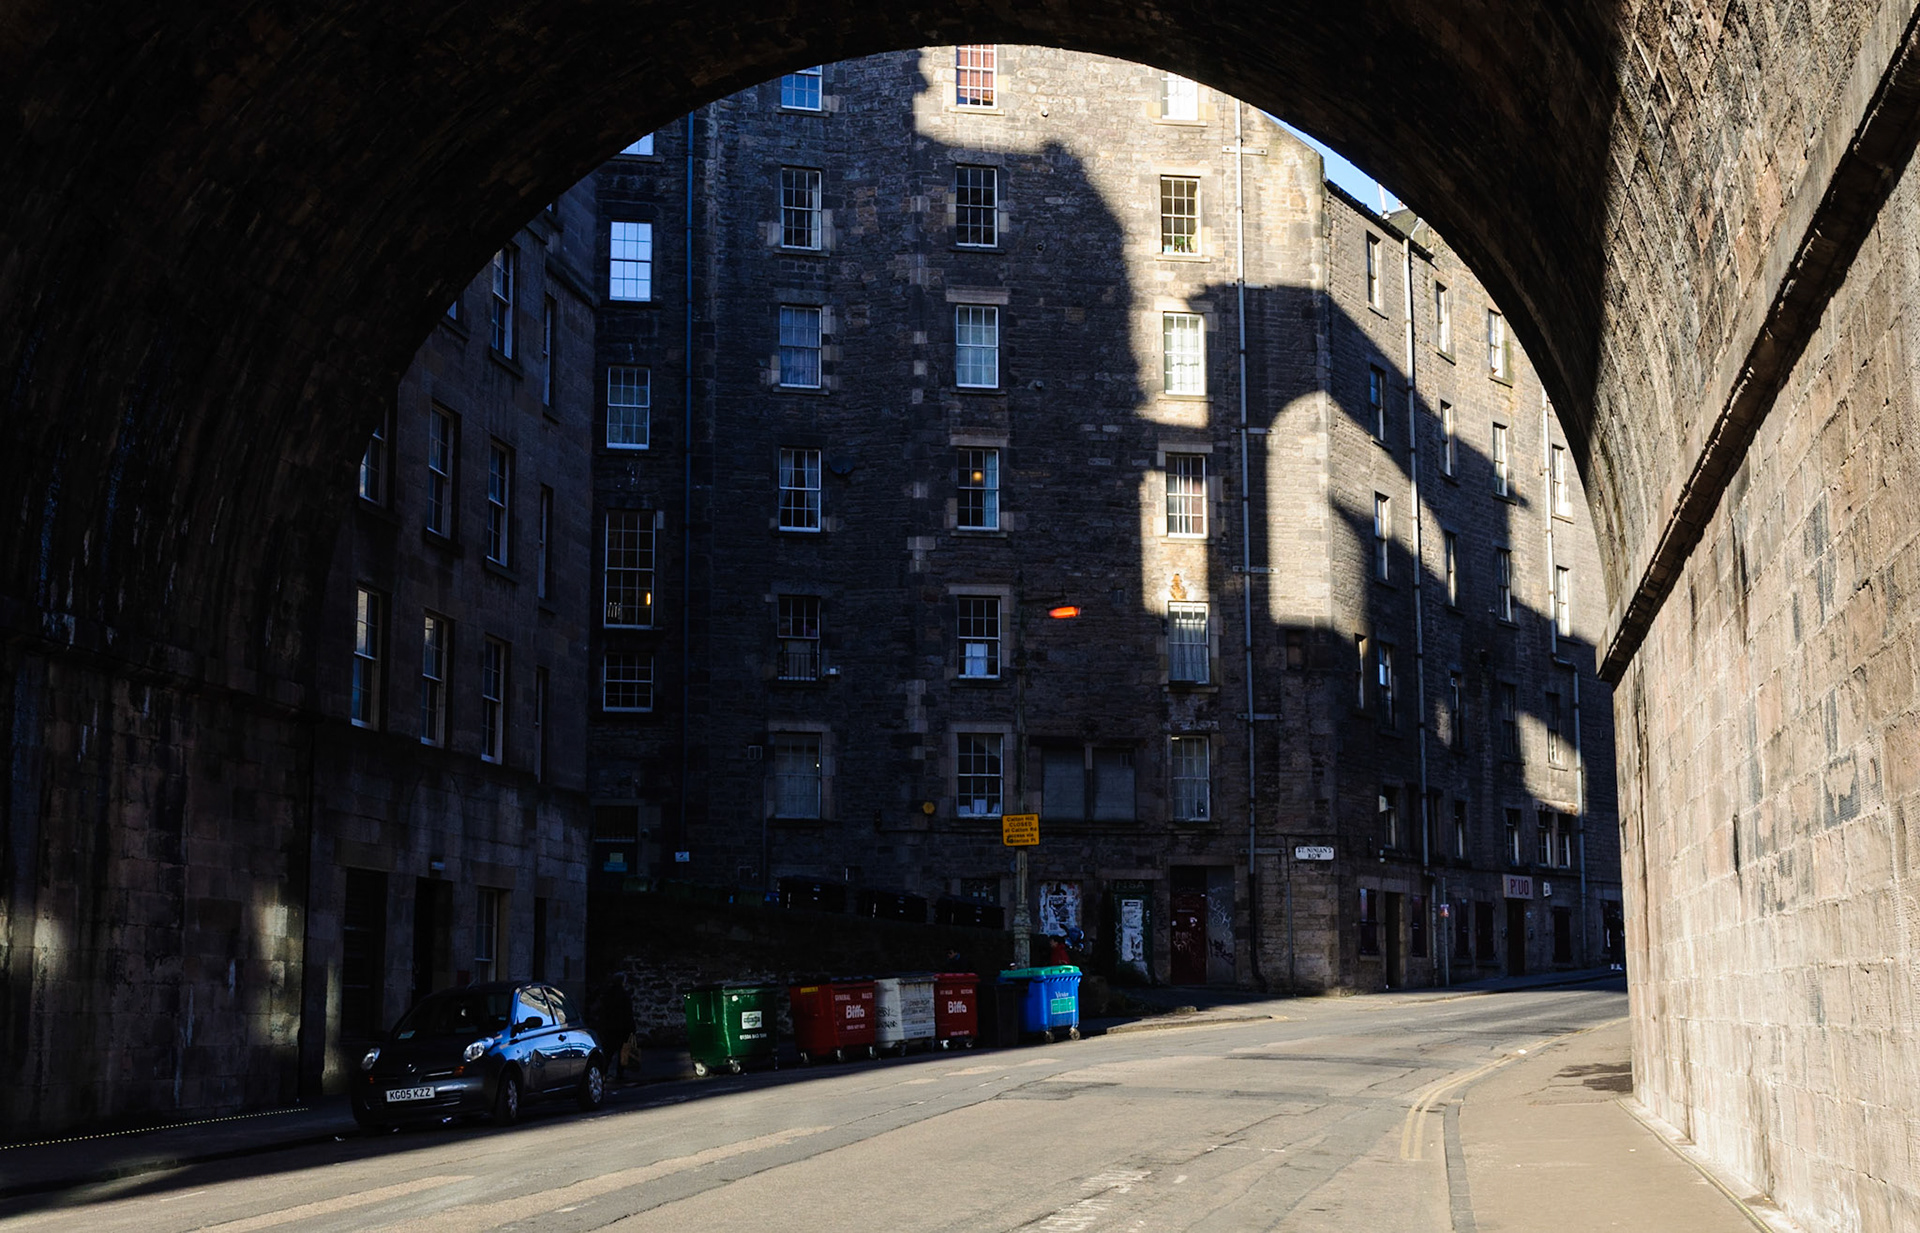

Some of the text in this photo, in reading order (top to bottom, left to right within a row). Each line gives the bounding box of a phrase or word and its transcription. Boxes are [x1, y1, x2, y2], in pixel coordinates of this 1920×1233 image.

[846, 1004, 865, 1019] Biffa
[948, 1000, 967, 1014] Biffa
[390, 1088, 431, 1100] KG05 KZZ
